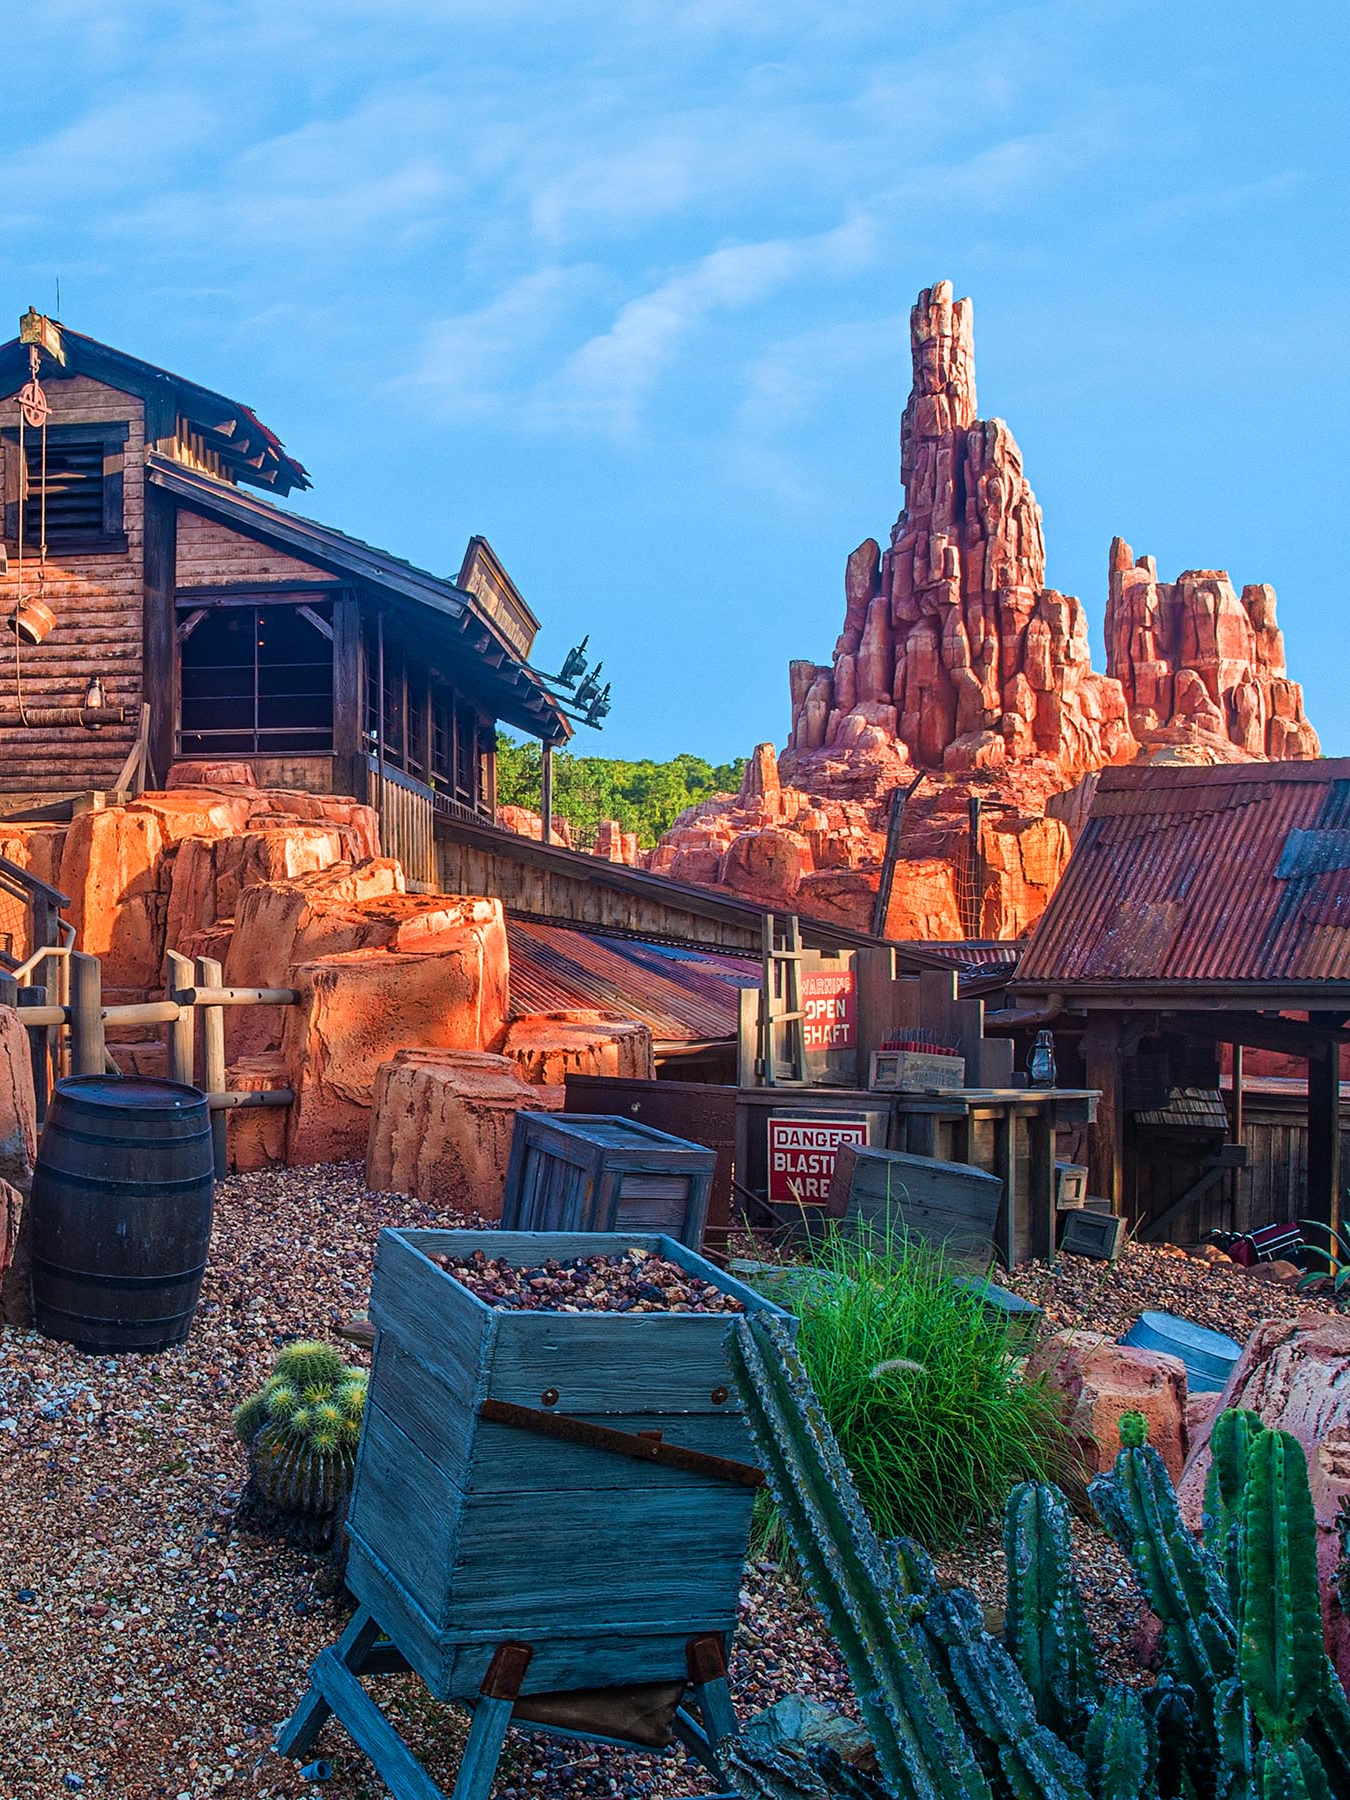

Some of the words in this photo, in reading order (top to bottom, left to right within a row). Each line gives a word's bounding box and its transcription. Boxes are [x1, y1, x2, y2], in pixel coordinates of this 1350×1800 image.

[801, 977, 851, 995] WARNING
[805, 999, 846, 1020] OPEN
[803, 1023, 850, 1045] SHAFT
[794, 1177, 830, 1198] ARE
